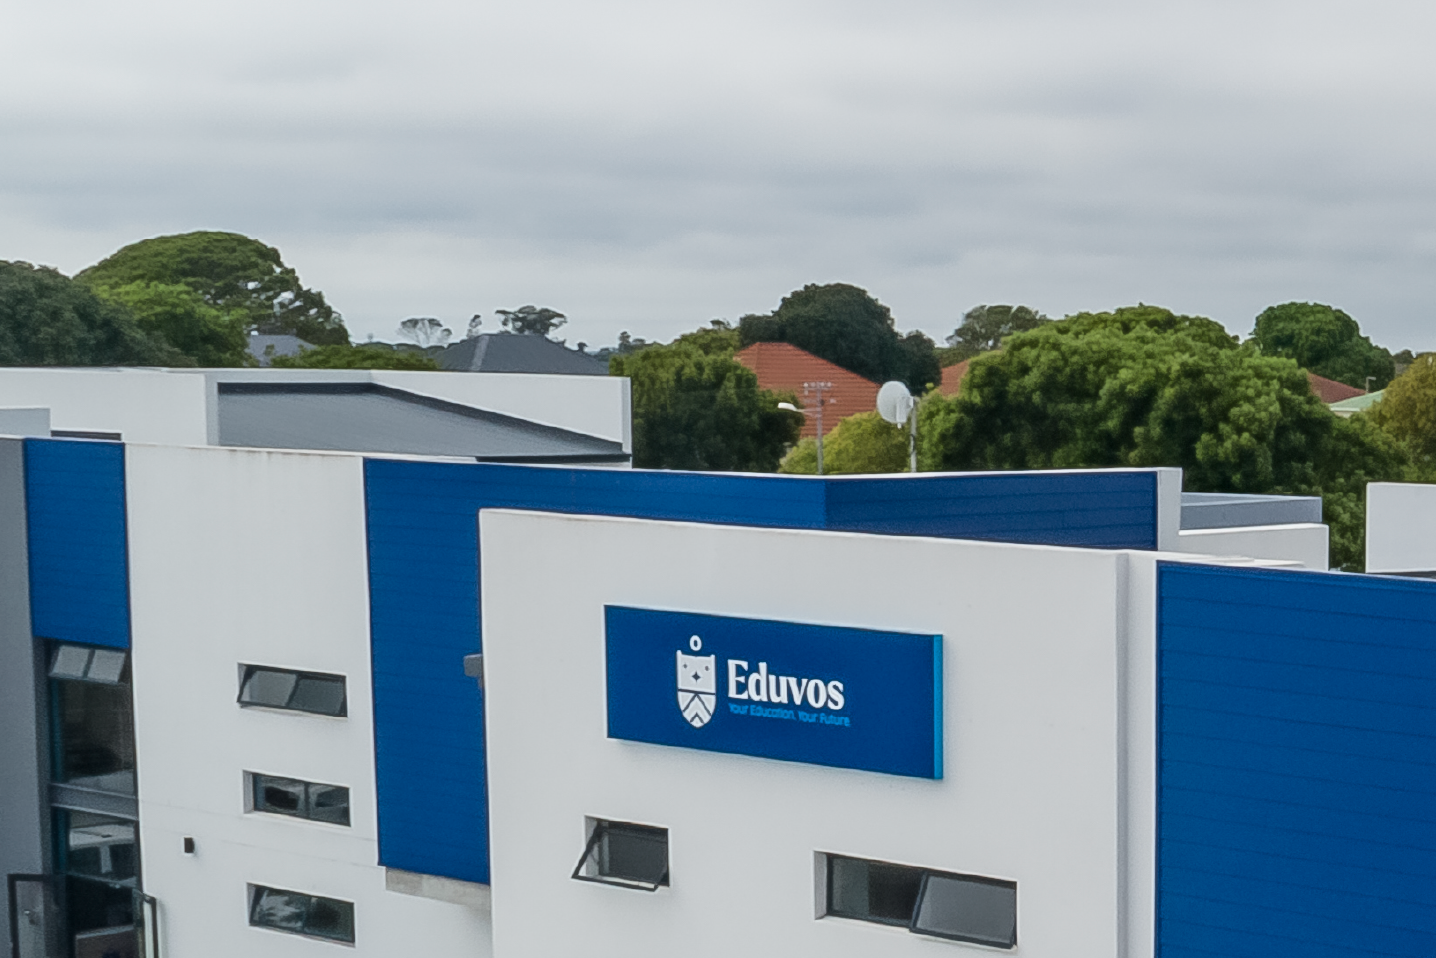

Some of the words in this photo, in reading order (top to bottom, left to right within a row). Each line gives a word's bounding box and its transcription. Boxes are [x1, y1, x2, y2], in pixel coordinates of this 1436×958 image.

[727, 658, 845, 710] Eduvos
[728, 702, 749, 715] Your
[798, 710, 817, 723] Your
